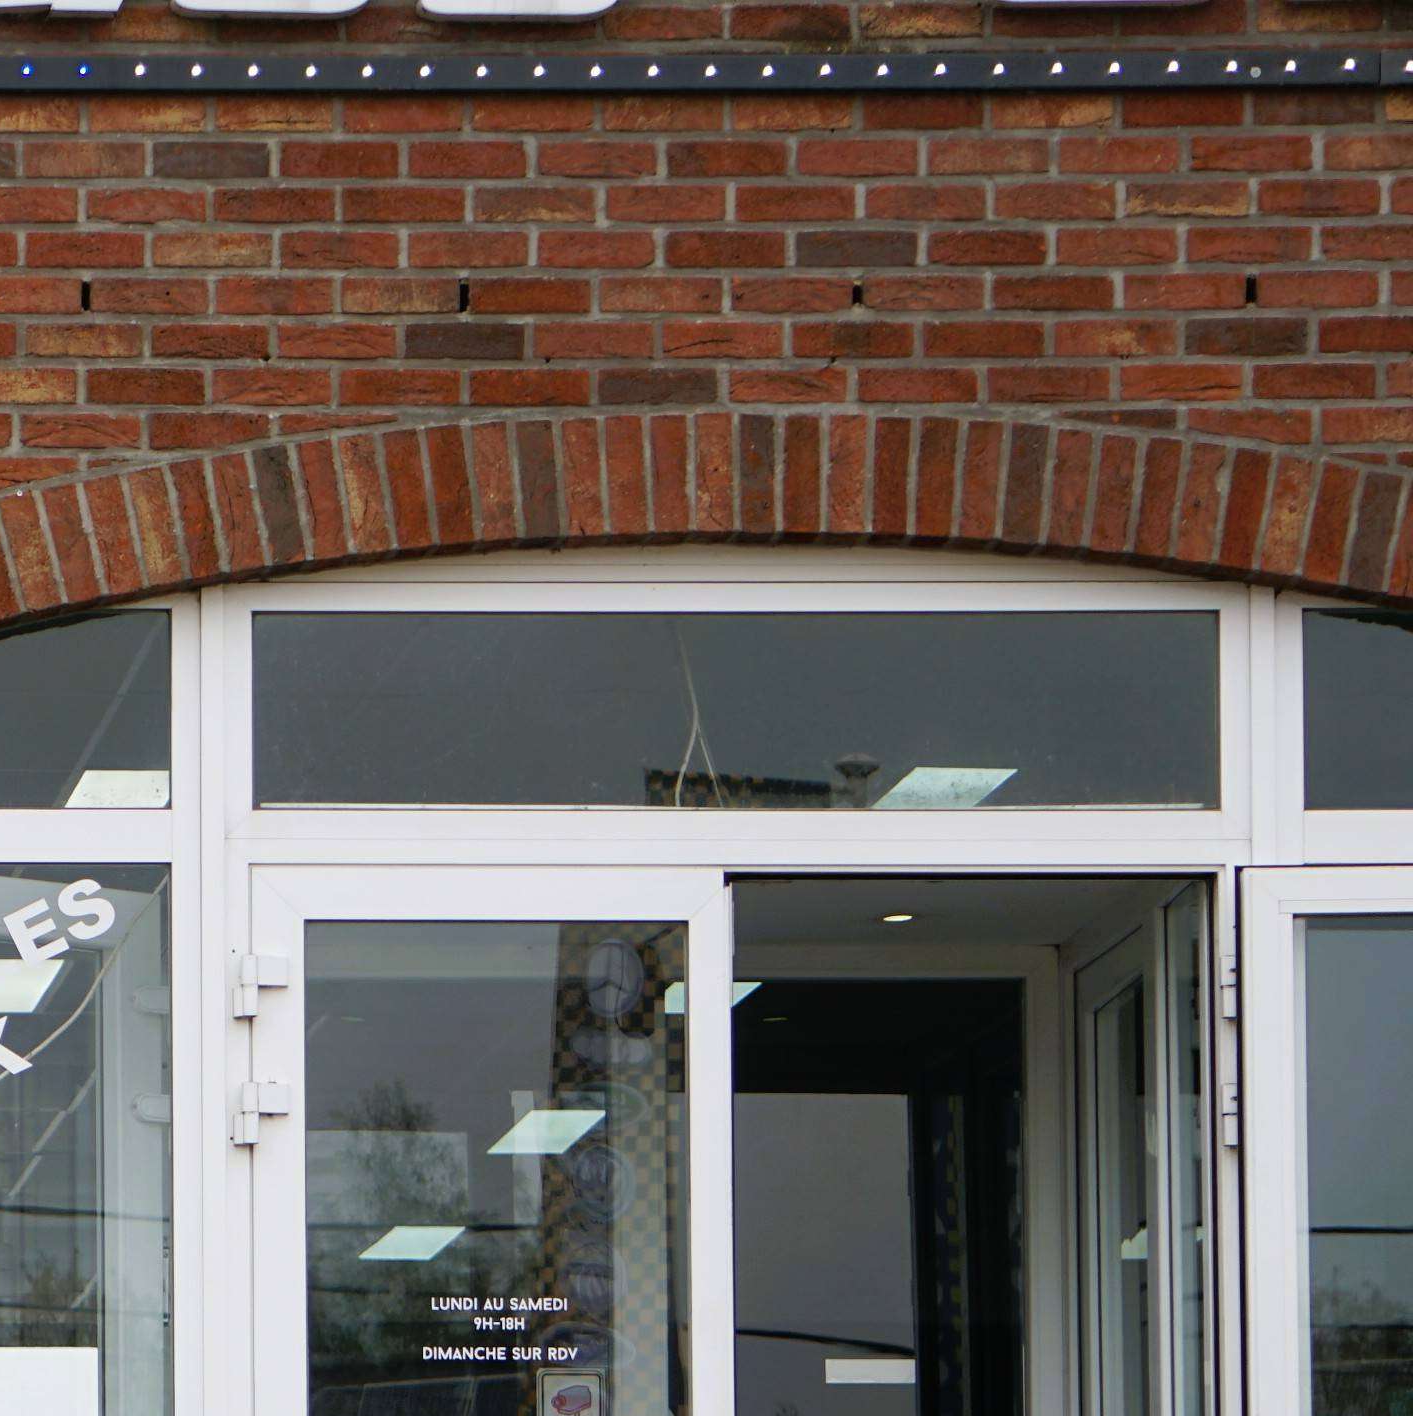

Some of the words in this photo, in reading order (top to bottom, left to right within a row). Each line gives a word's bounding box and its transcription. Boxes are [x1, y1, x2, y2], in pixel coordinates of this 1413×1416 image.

[430, 1296, 478, 1312] LUNDI
[483, 1296, 504, 1312] AU
[509, 1296, 568, 1312] SAMEDI
[473, 1316, 525, 1331] 9H-18H
[422, 1346, 507, 1361] DIMANCHE
[511, 1346, 542, 1361] SUR
[547, 1346, 579, 1361] RDV
